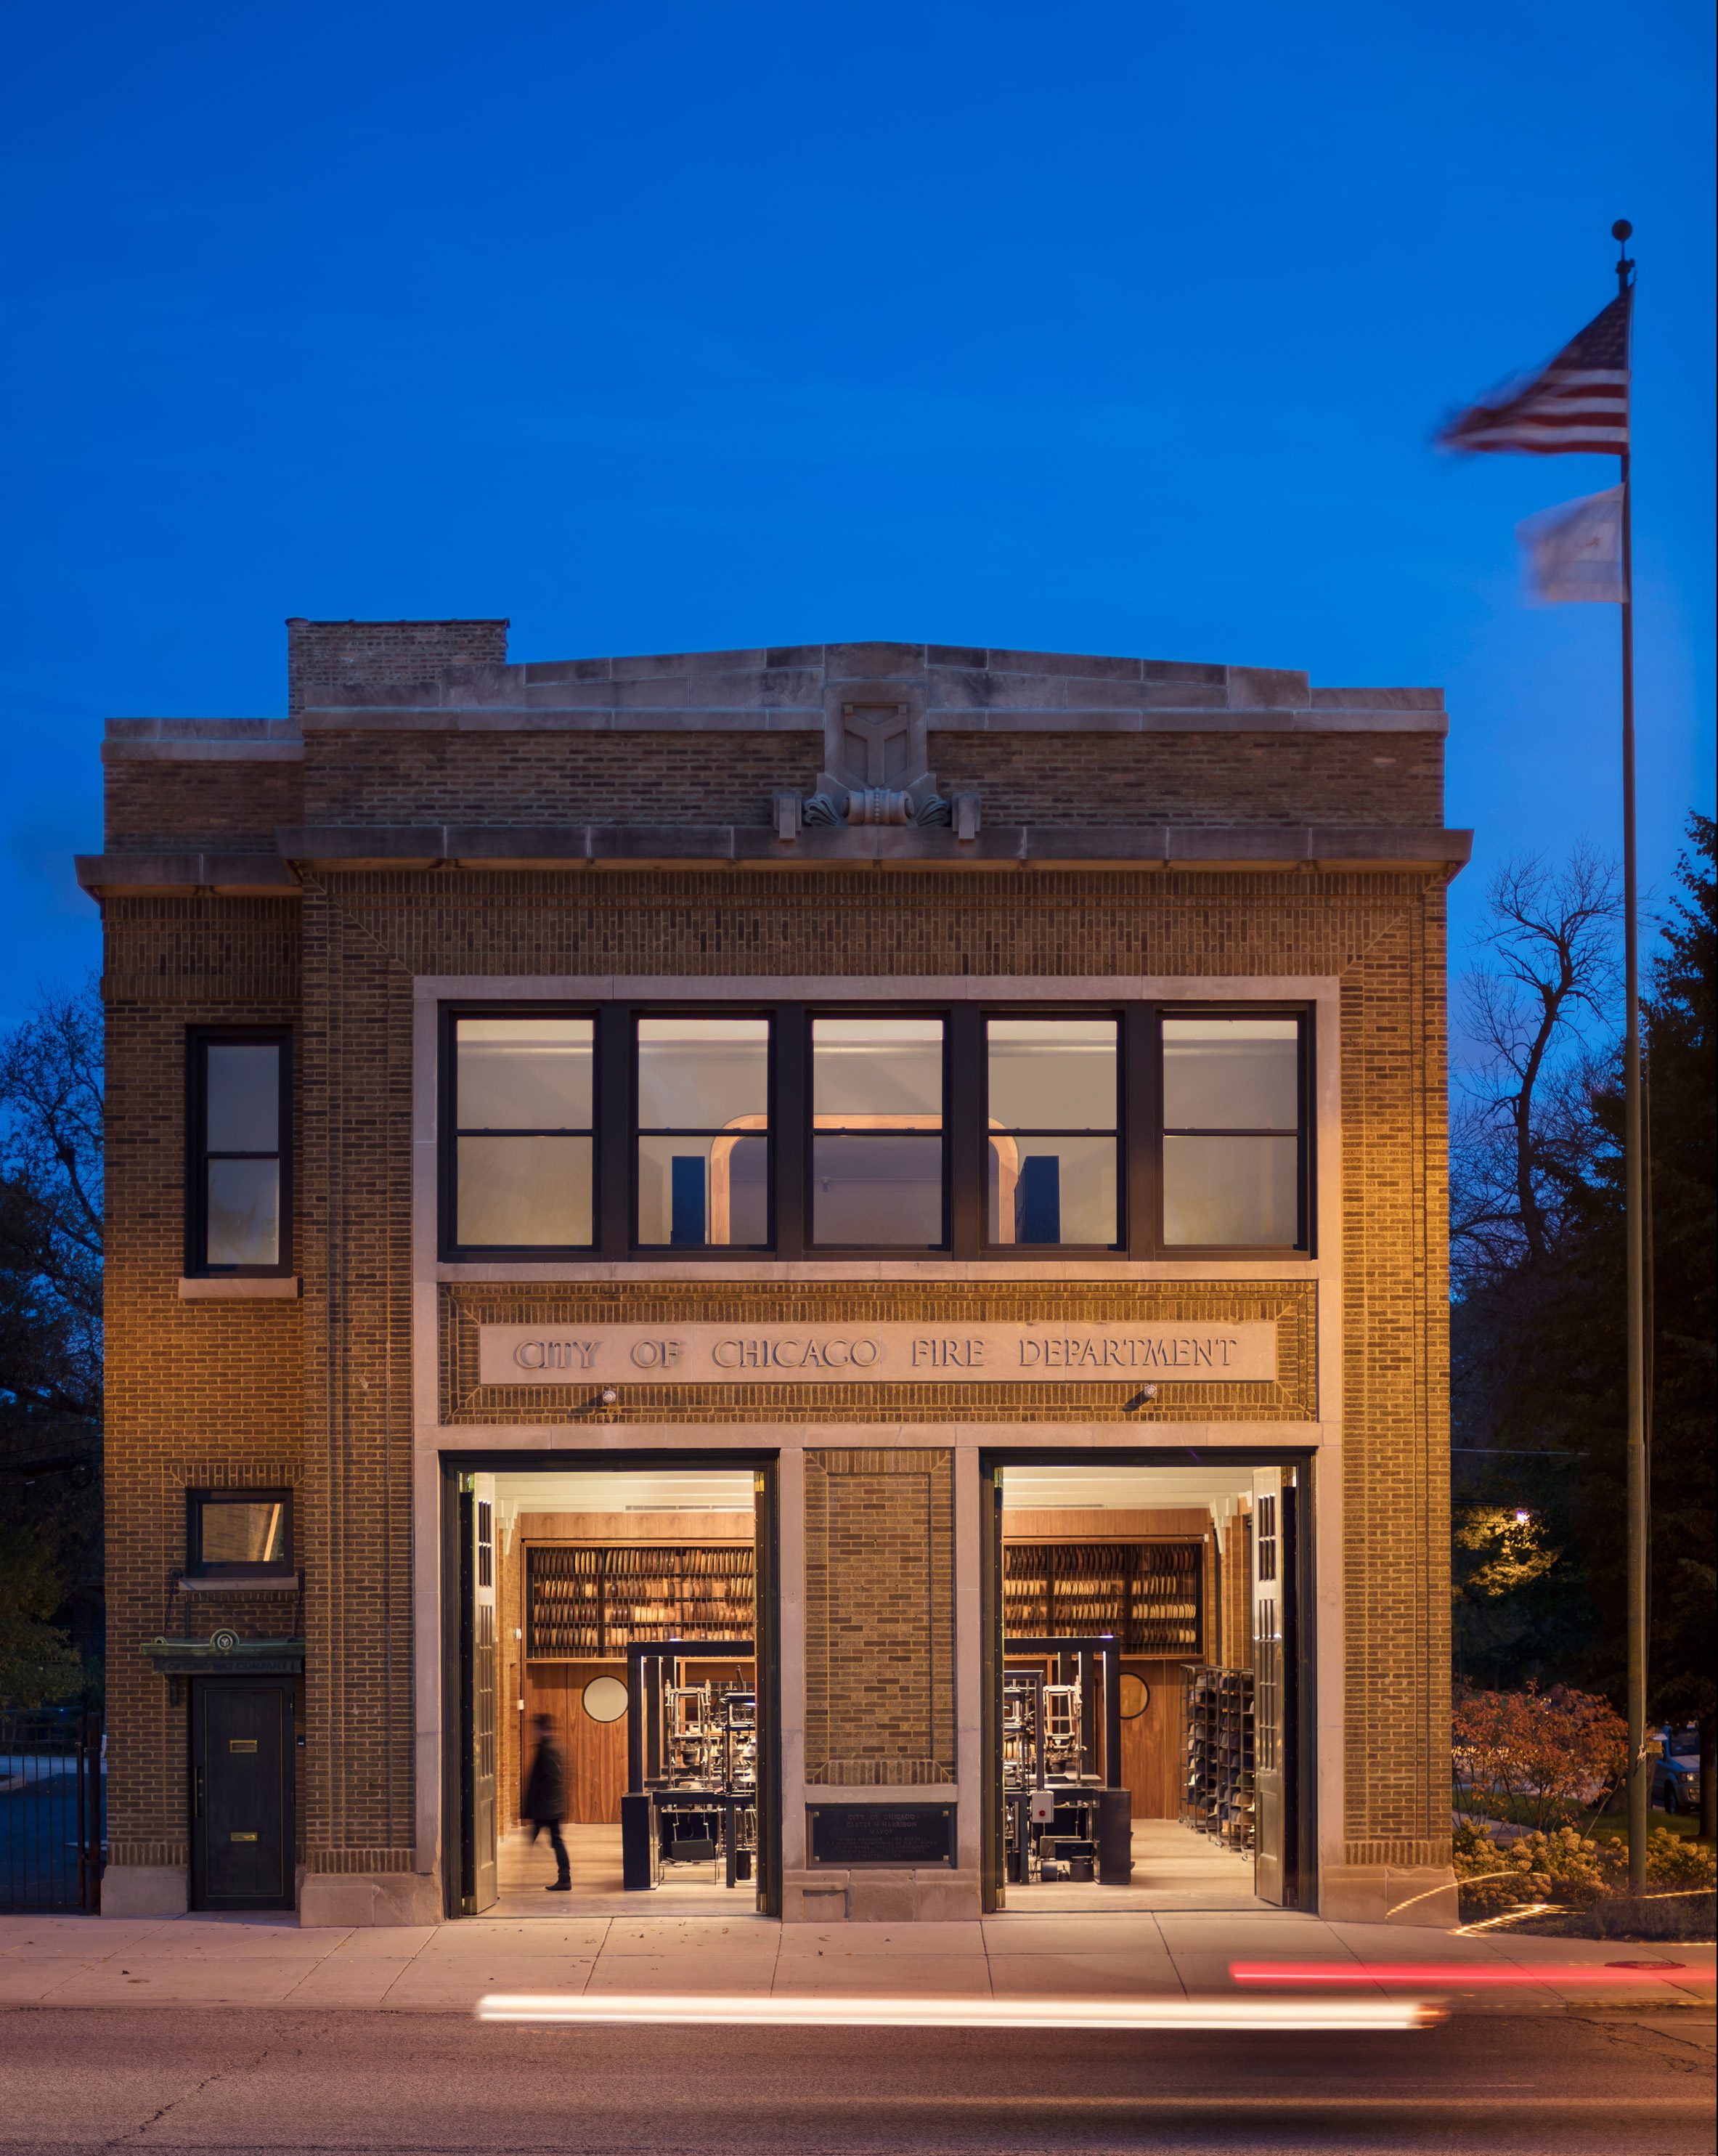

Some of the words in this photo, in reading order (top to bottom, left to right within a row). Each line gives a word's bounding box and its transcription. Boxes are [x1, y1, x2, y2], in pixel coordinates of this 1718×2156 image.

[514, 1340, 600, 1369] CITY
[630, 1339, 683, 1368] OF
[712, 1338, 880, 1368] CHICAGO
[911, 1338, 987, 1367] FIRE
[1018, 1338, 1238, 1367] DEPARTMENT
